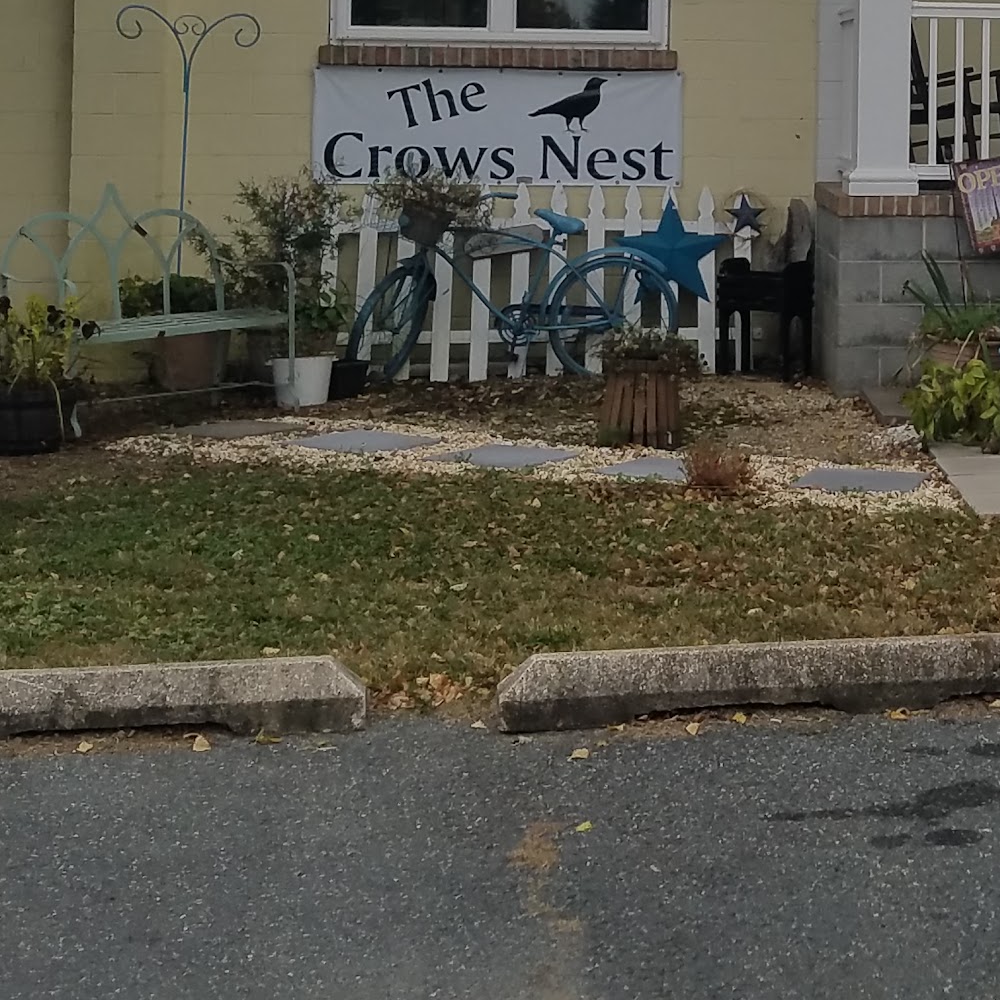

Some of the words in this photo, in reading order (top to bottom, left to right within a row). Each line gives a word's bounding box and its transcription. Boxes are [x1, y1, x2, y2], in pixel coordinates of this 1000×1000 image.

[387, 78, 488, 128] The
[324, 132, 516, 180] Crows
[540, 135, 674, 181] Nest
